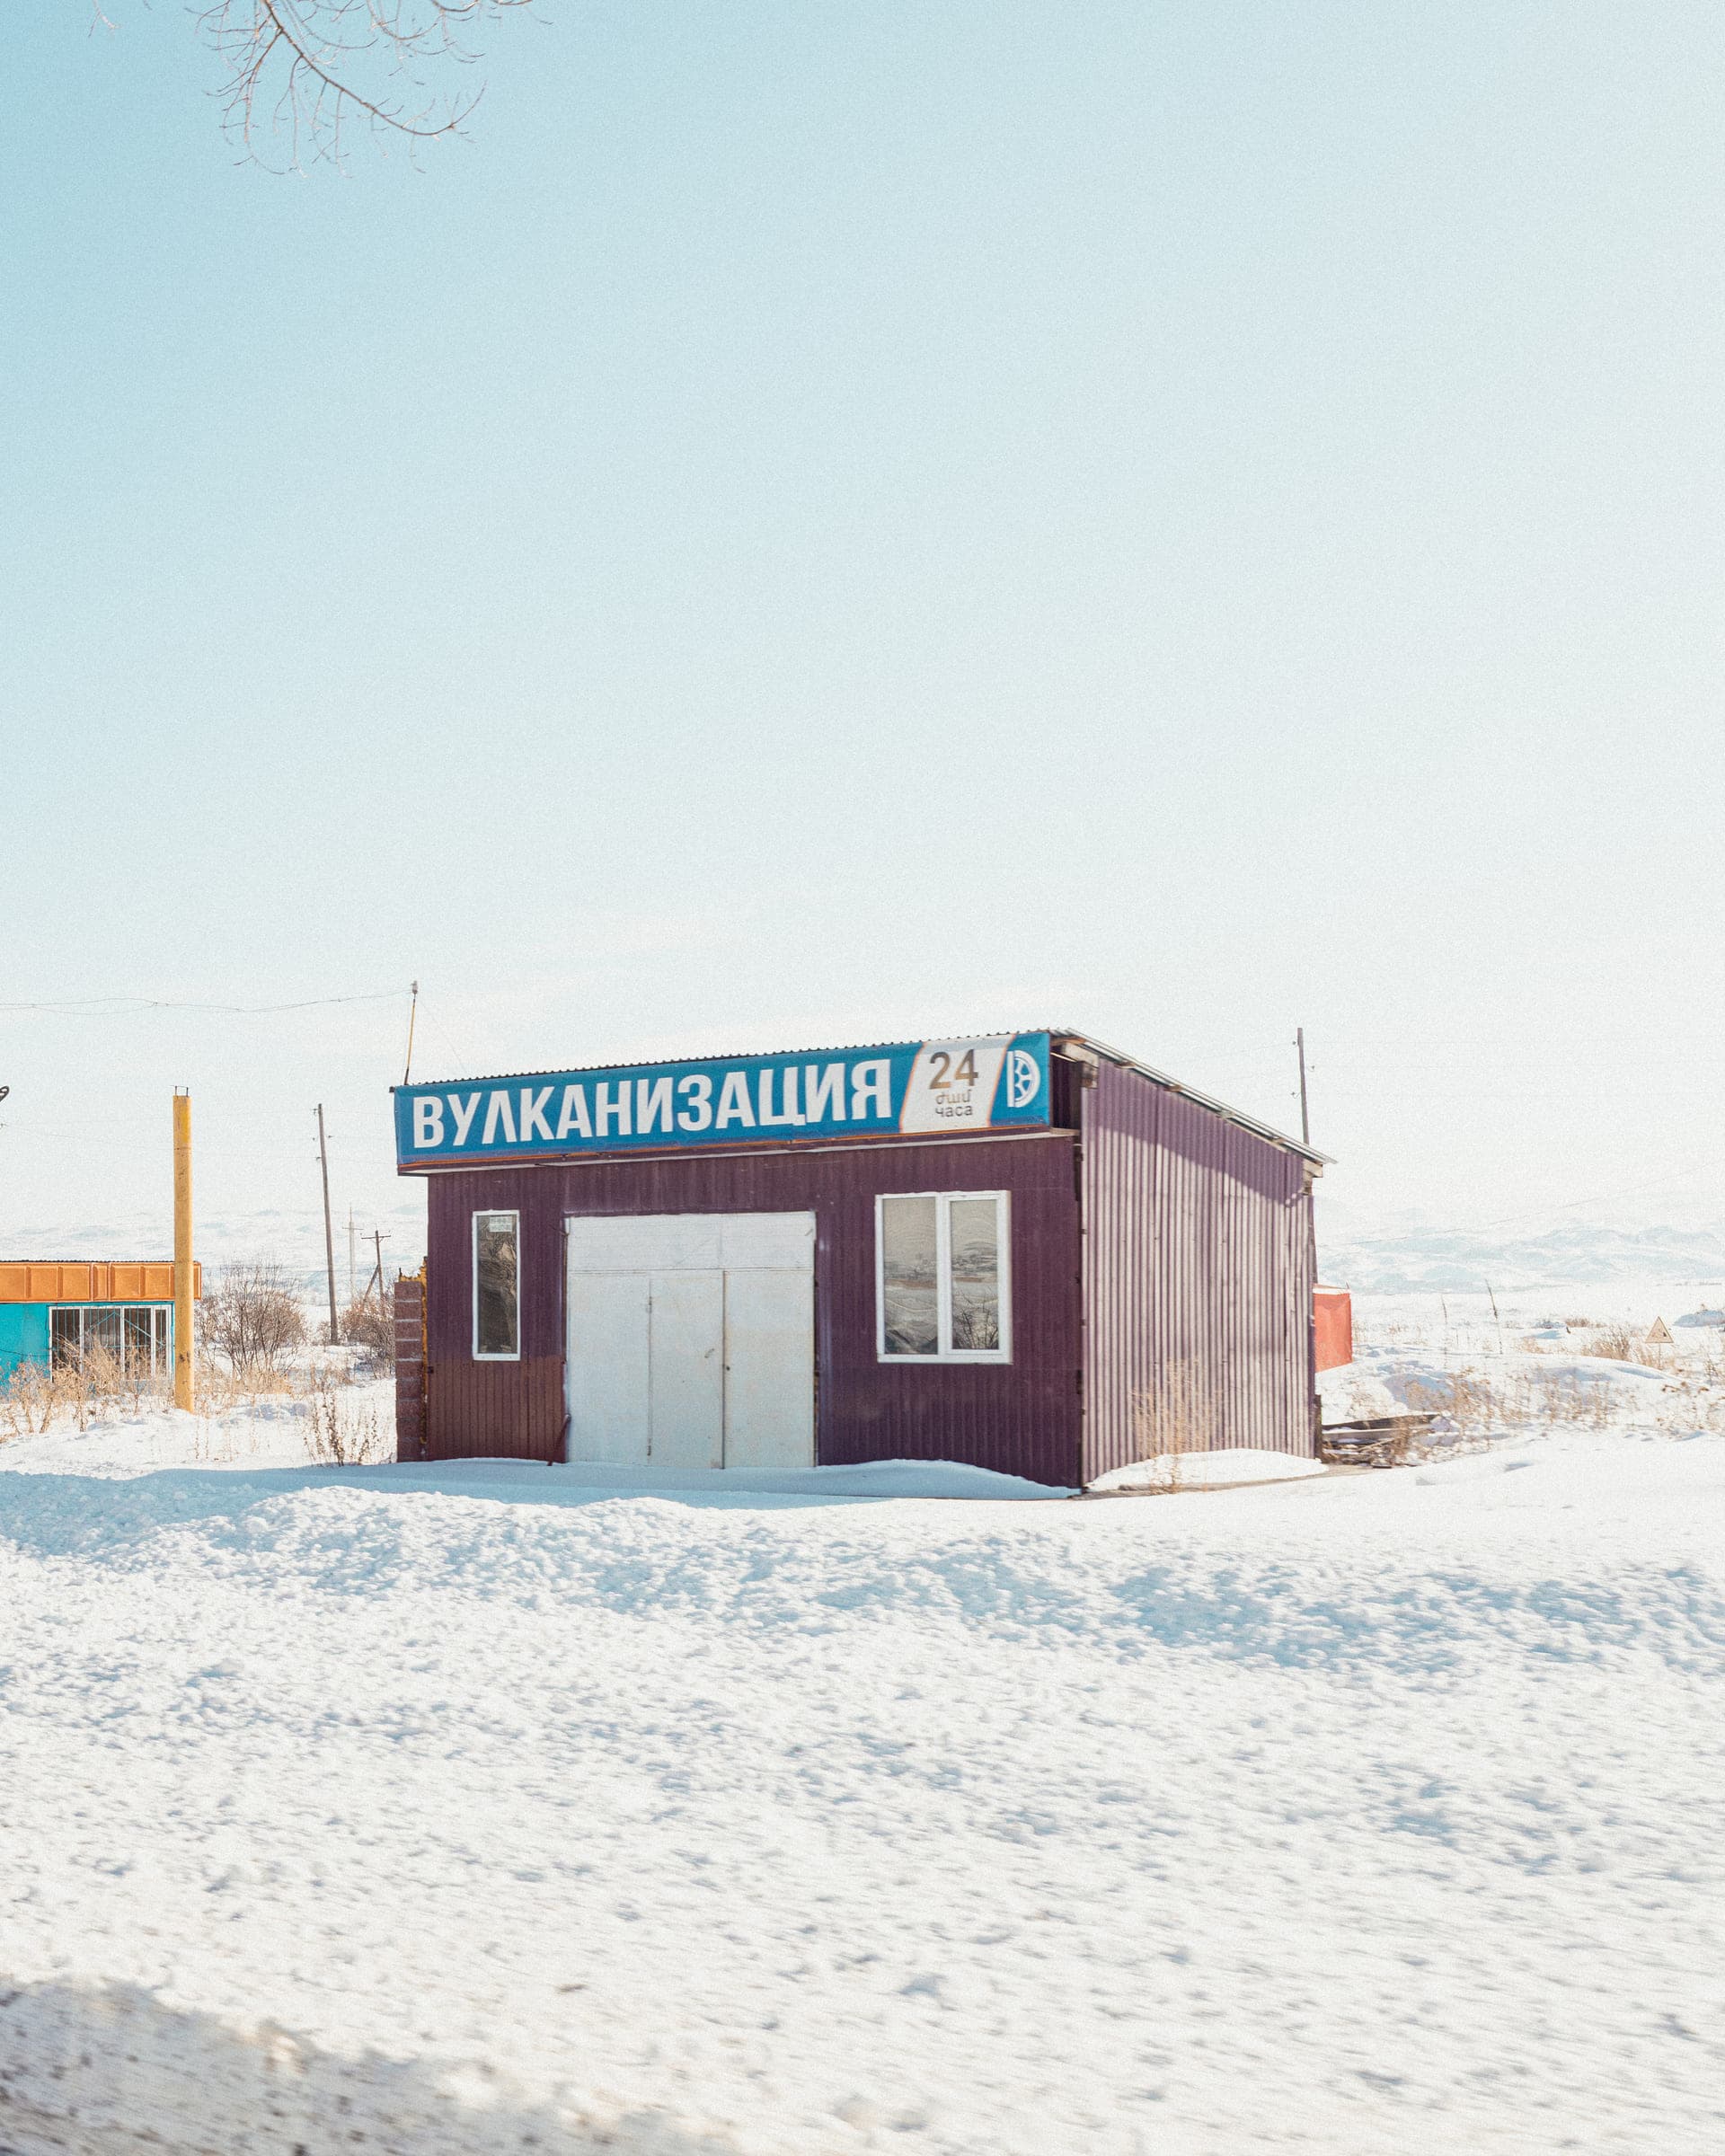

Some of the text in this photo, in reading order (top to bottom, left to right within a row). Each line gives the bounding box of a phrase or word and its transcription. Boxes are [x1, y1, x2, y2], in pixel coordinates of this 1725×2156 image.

[929, 1048, 979, 1090] 24
[413, 1059, 892, 1149] ВУЛКАНИЗАЦИЯ
[934, 1105, 974, 1118] часа
